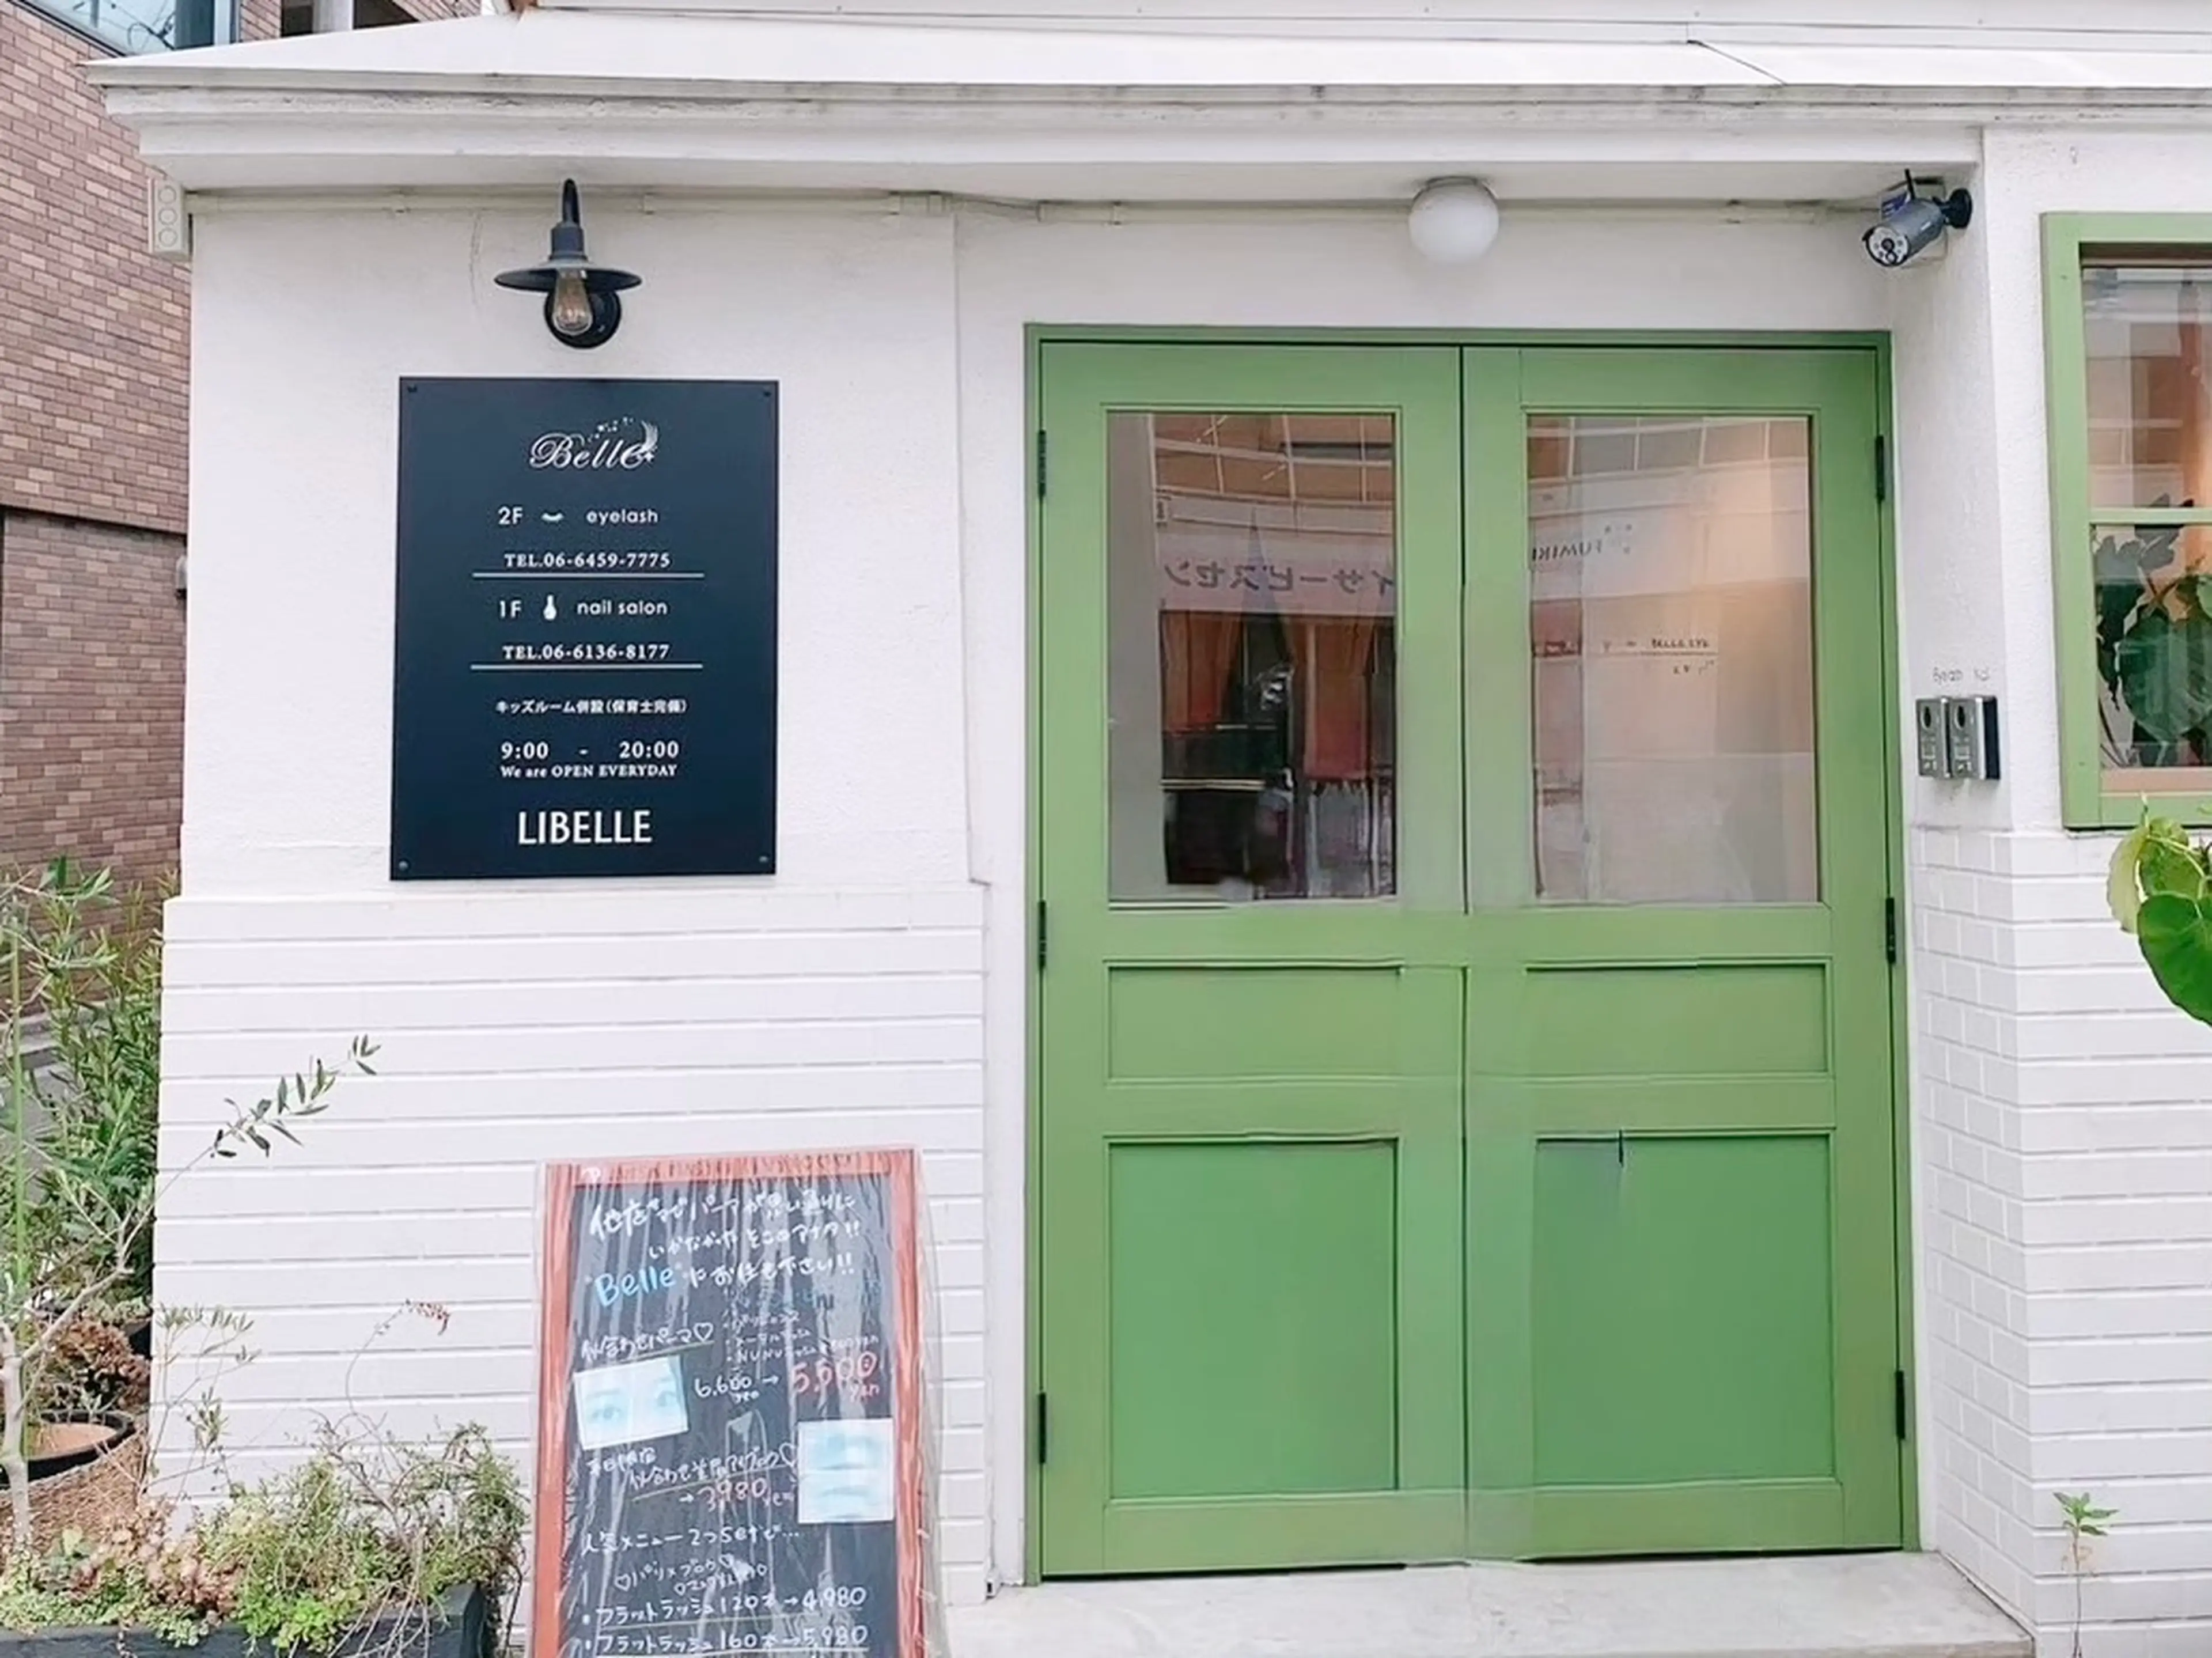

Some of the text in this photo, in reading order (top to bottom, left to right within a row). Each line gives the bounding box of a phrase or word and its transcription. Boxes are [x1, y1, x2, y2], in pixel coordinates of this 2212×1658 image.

[529, 432, 653, 469] Belle
[498, 506, 658, 526] 2F eyelash
[504, 552, 671, 568] TEL.06-6459-7775
[499, 599, 668, 618] 1F nail salon
[502, 643, 669, 660] TEL.06-6136-8177
[501, 741, 549, 760] 9:00
[619, 740, 679, 759] 20:00
[500, 764, 677, 778] We are OPEN EVERYDAY
[518, 809, 653, 845] LIBELLE
[594, 1265, 676, 1307] Belle
